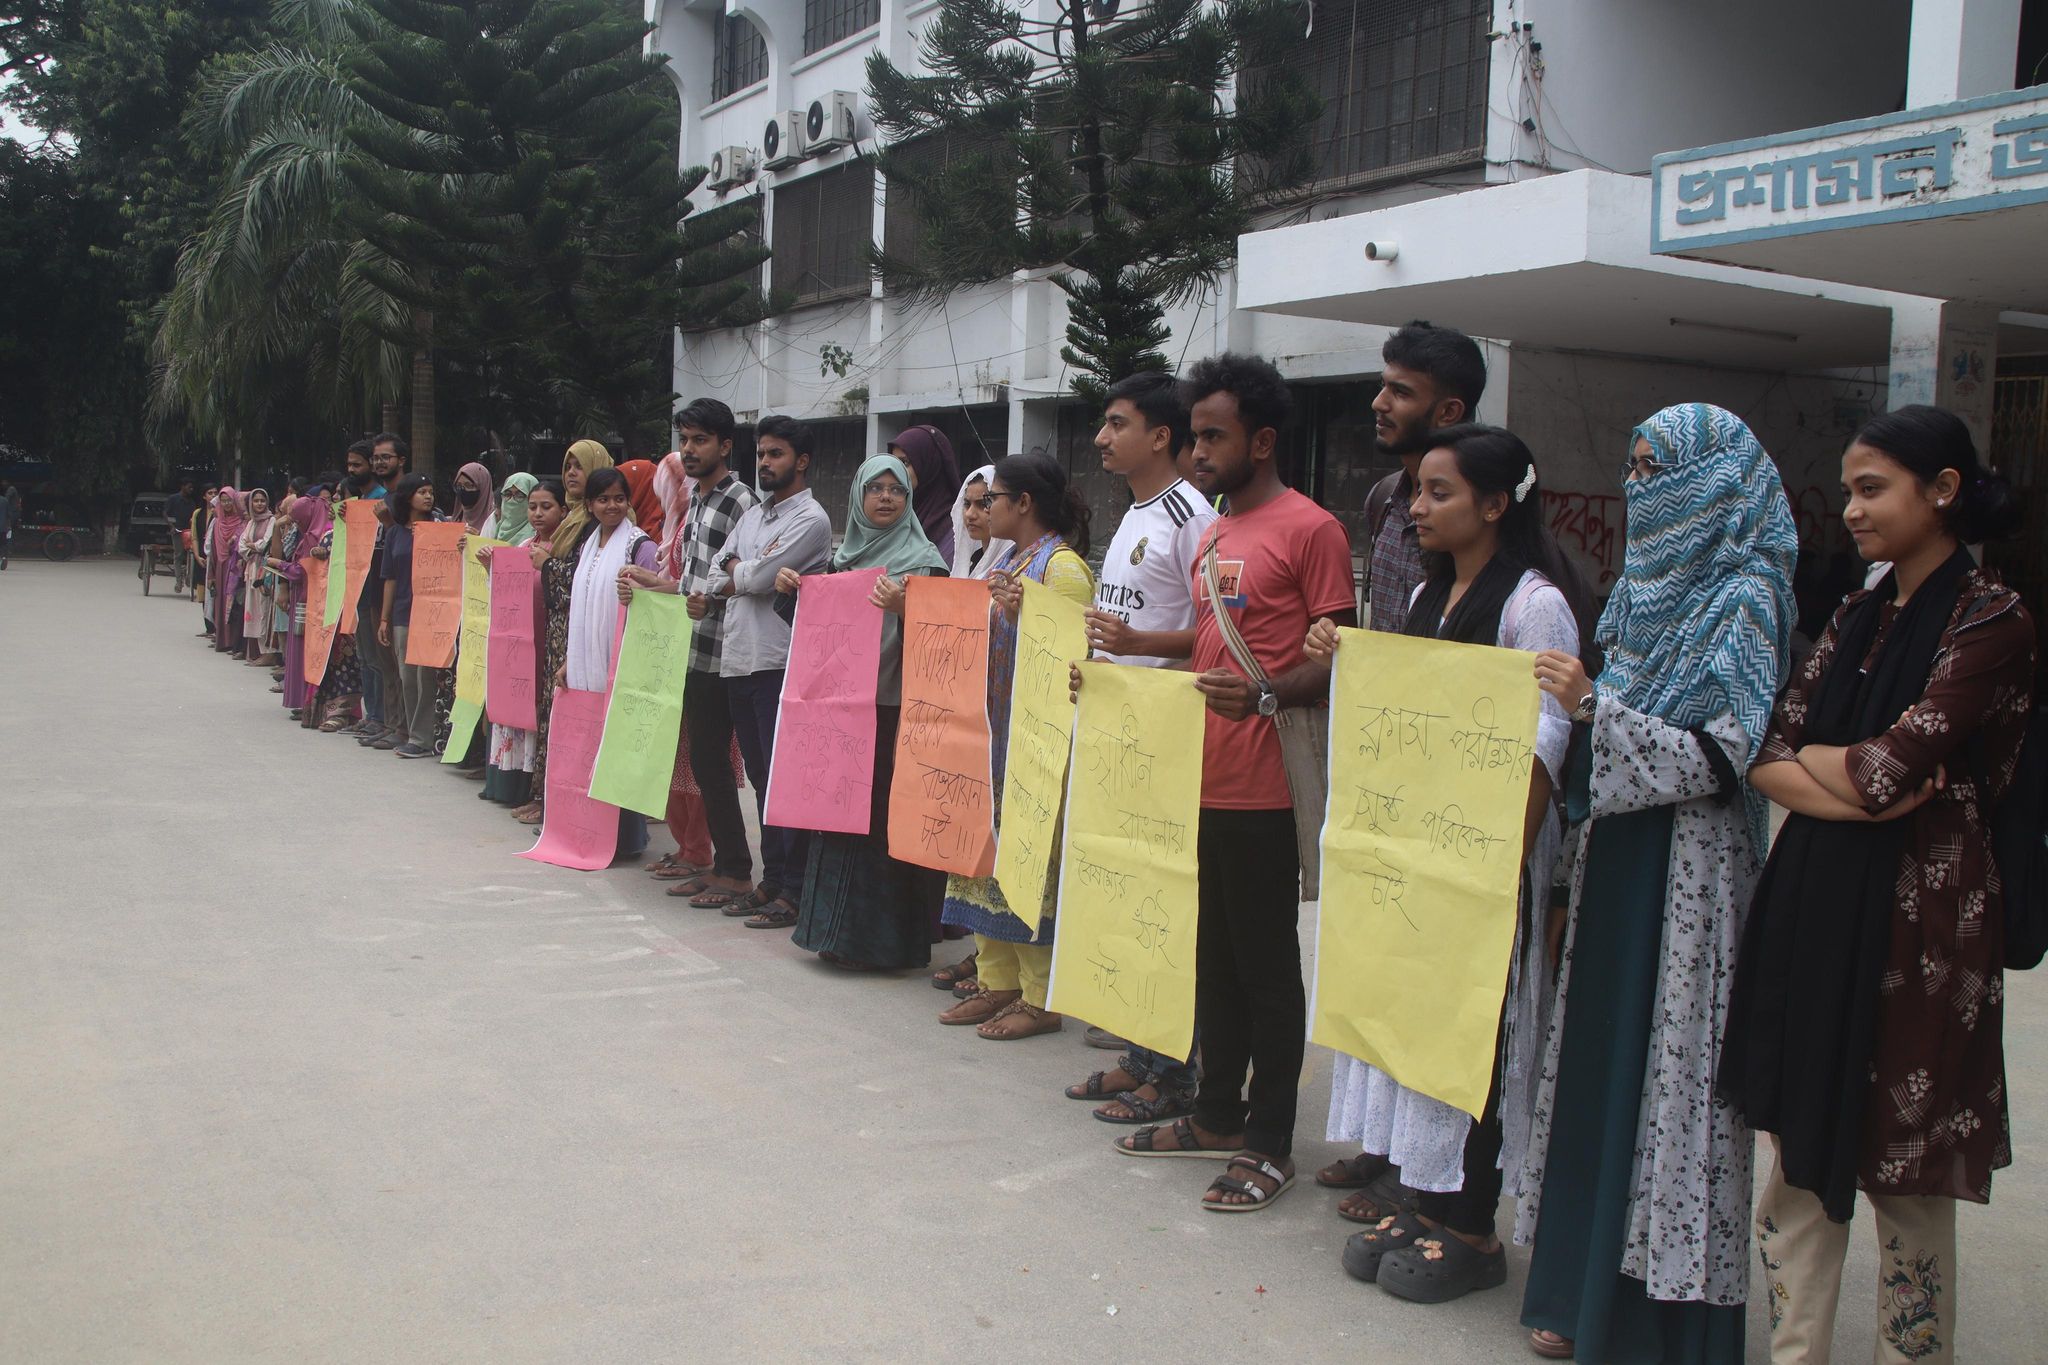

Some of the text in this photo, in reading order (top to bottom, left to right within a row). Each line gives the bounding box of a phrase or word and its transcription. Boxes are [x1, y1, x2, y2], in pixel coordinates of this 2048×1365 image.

[1676, 127, 1961, 225] প্রশাসন
[1218, 571, 1237, 592] ger
[1421, 803, 1507, 862] পরিবেশ
[1363, 848, 1419, 931] চাই
[1135, 976, 1158, 1014] !!!
